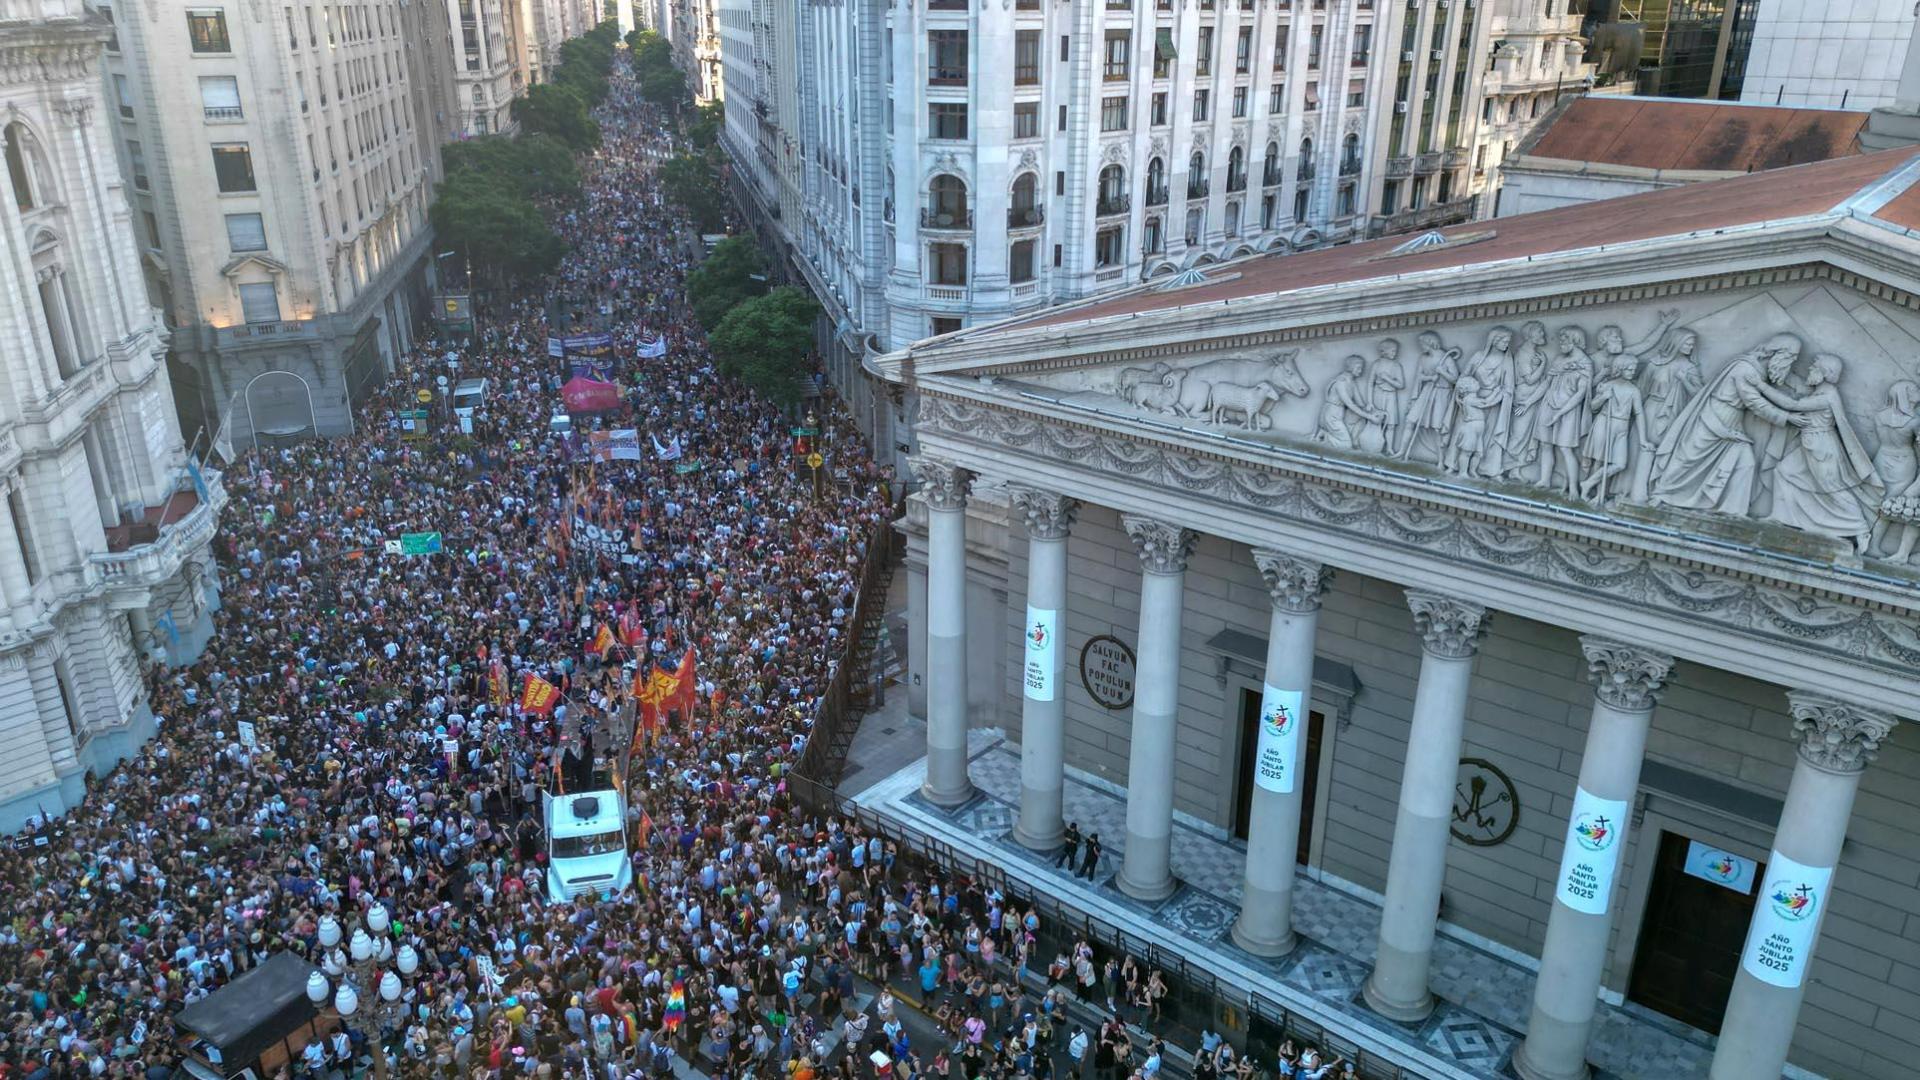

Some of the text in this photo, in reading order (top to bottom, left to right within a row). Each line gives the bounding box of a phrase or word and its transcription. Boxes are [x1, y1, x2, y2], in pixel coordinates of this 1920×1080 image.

[575, 517, 623, 542] POLO
[1093, 644, 1127, 664] SALVUM
[1102, 660, 1119, 673] FAC
[1026, 678, 1042, 689] 2025
[1089, 668, 1130, 690] POPULUM
[1095, 682, 1123, 701] TUUM
[1263, 753, 1282, 764] SANTO
[1261, 767, 1282, 780] 2025
[1572, 868, 1597, 882] SANTO
[1576, 863, 1593, 873] AÑO
[1568, 876, 1598, 890] JUBILAR
[1568, 883, 1594, 899] 2025
[1765, 938, 1793, 953] SANTO
[1771, 933, 1790, 944] AÑO
[1759, 946, 1794, 962] JUBILAR
[1758, 954, 1789, 972] 2025
